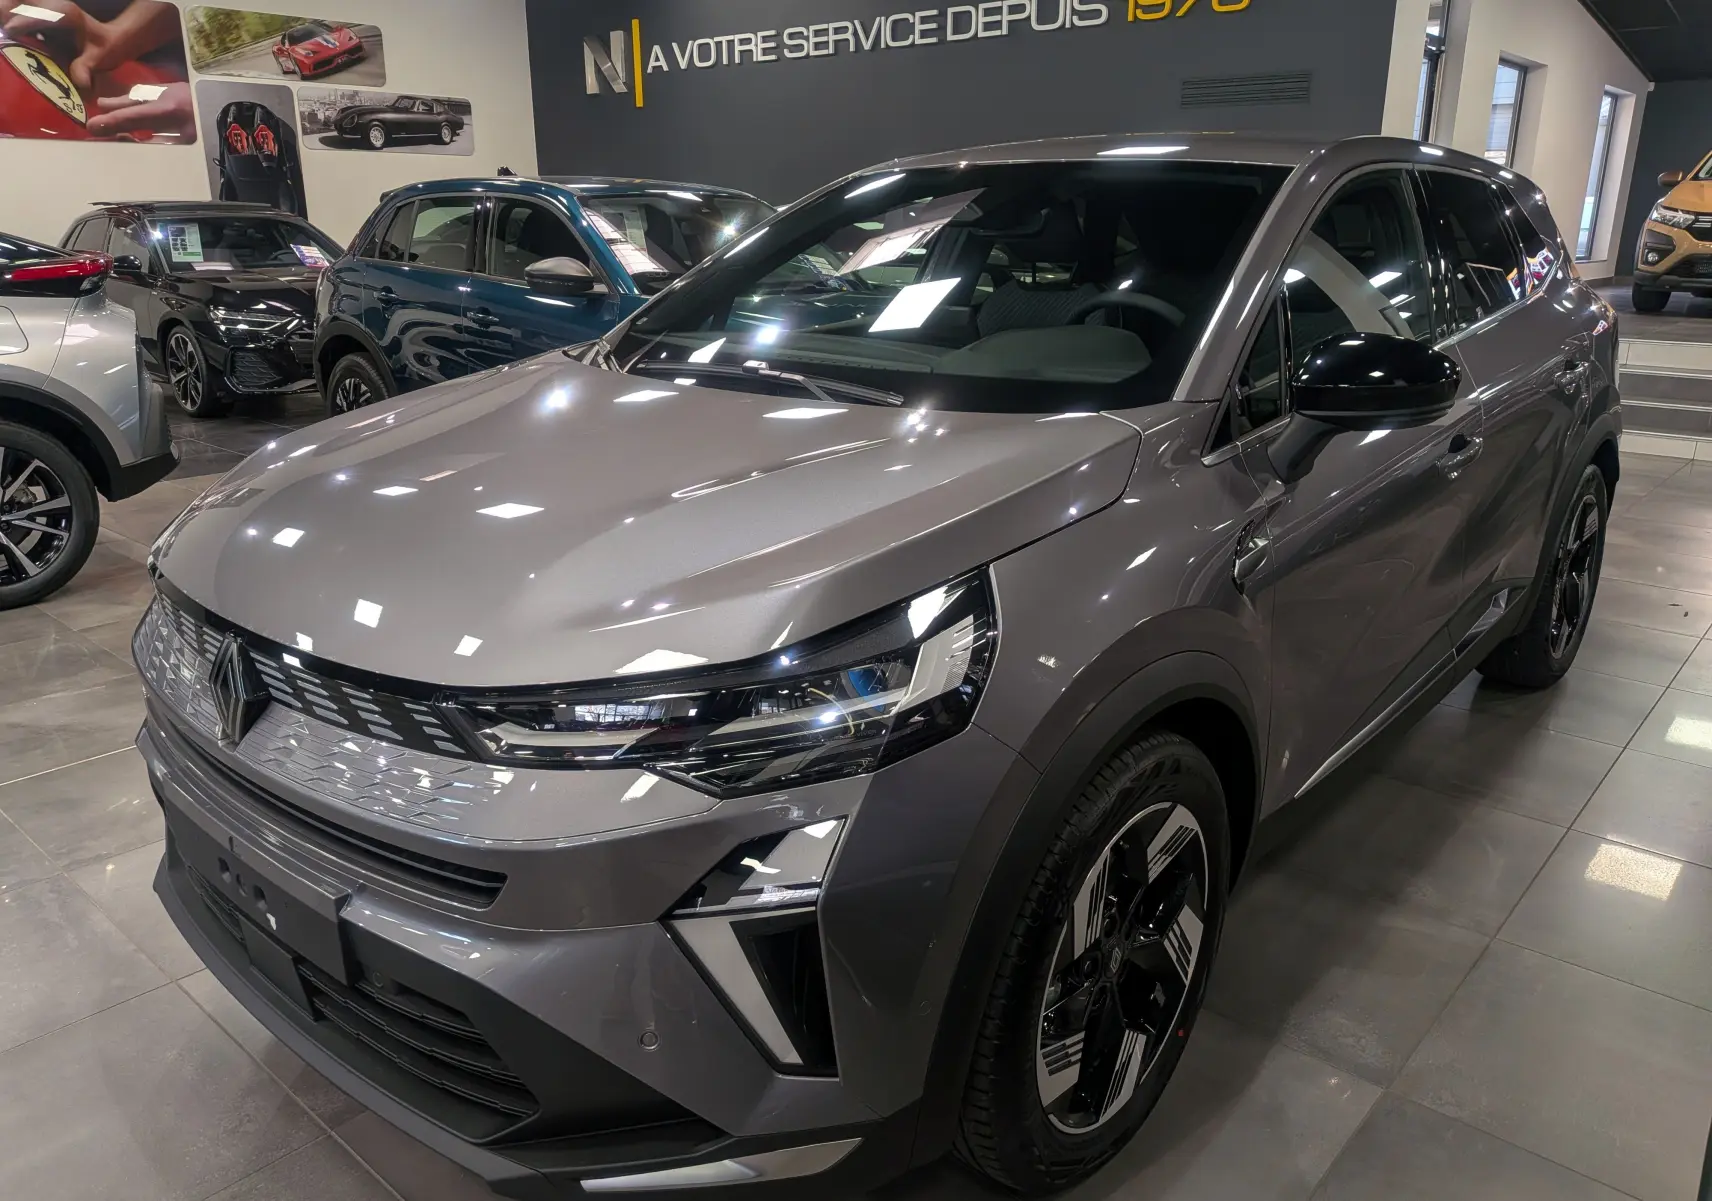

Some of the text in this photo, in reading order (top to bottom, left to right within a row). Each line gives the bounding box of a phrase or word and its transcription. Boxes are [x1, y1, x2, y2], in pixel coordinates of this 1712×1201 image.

[583, 30, 628, 94] N
[647, 44, 669, 73] A
[672, 29, 778, 70] VOTRE
[783, 9, 939, 58] SERVICE
[946, 0, 1108, 41] DEPUIS
